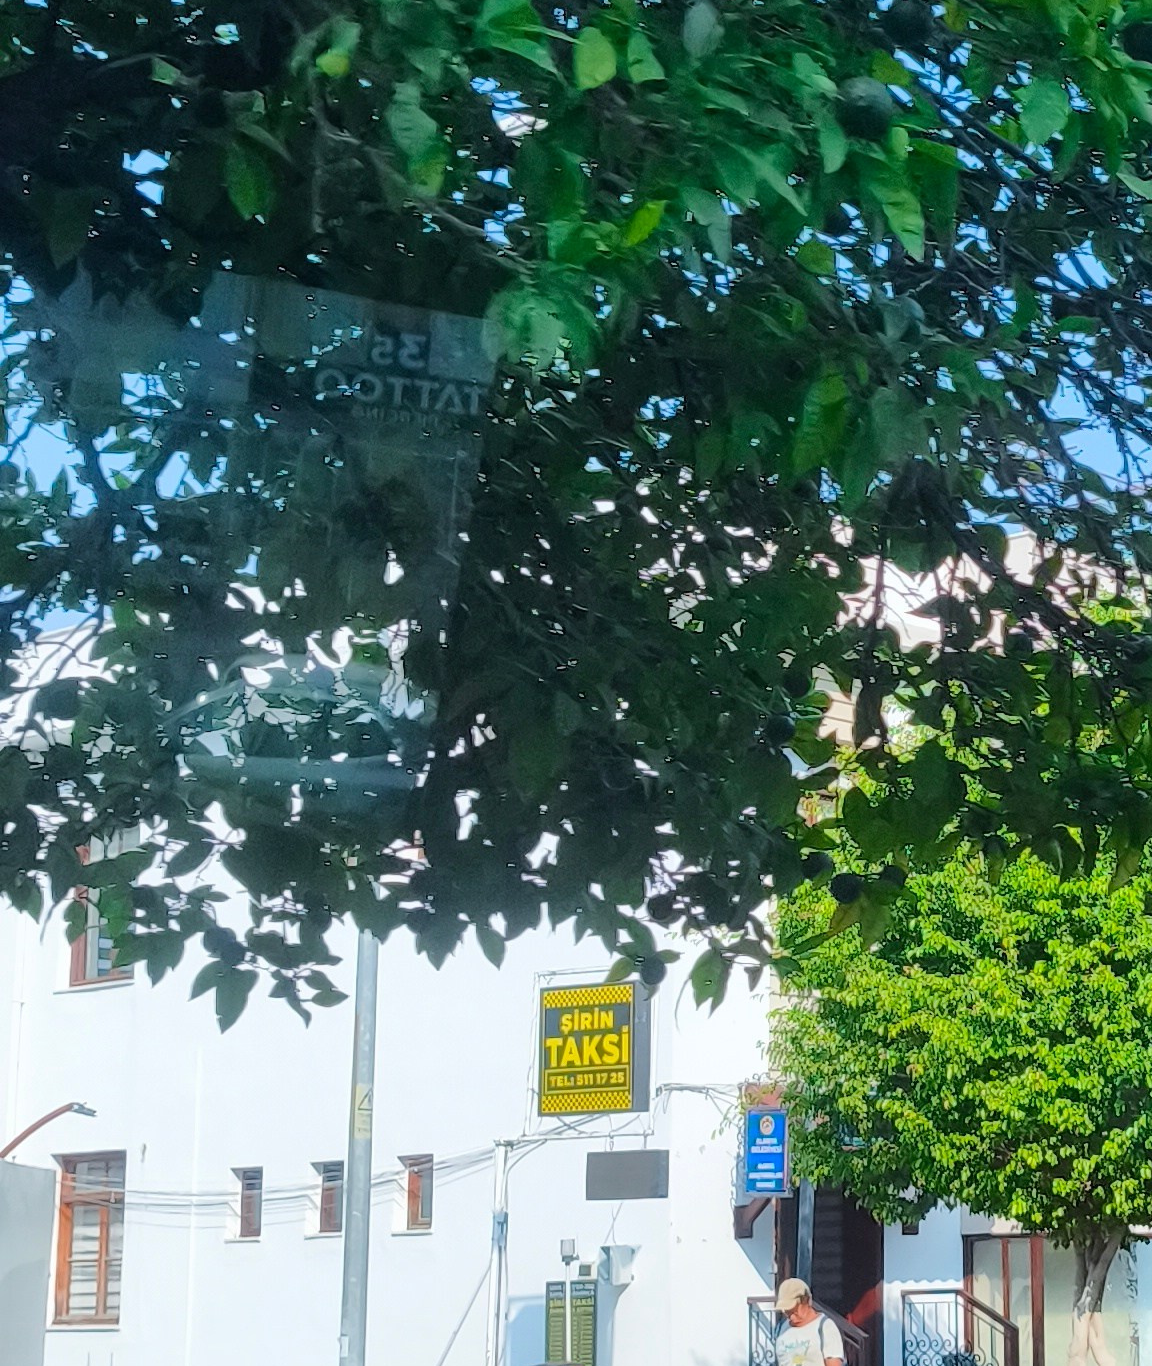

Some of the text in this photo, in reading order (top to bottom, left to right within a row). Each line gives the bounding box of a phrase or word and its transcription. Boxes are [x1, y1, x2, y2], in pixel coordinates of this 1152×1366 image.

[560, 1007, 614, 1035] ŞİRİN
[545, 1025, 629, 1067] TAKSİ
[576, 1073, 594, 1086] 511
[596, 1072, 608, 1084] 17
[610, 1072, 625, 1083] 25
